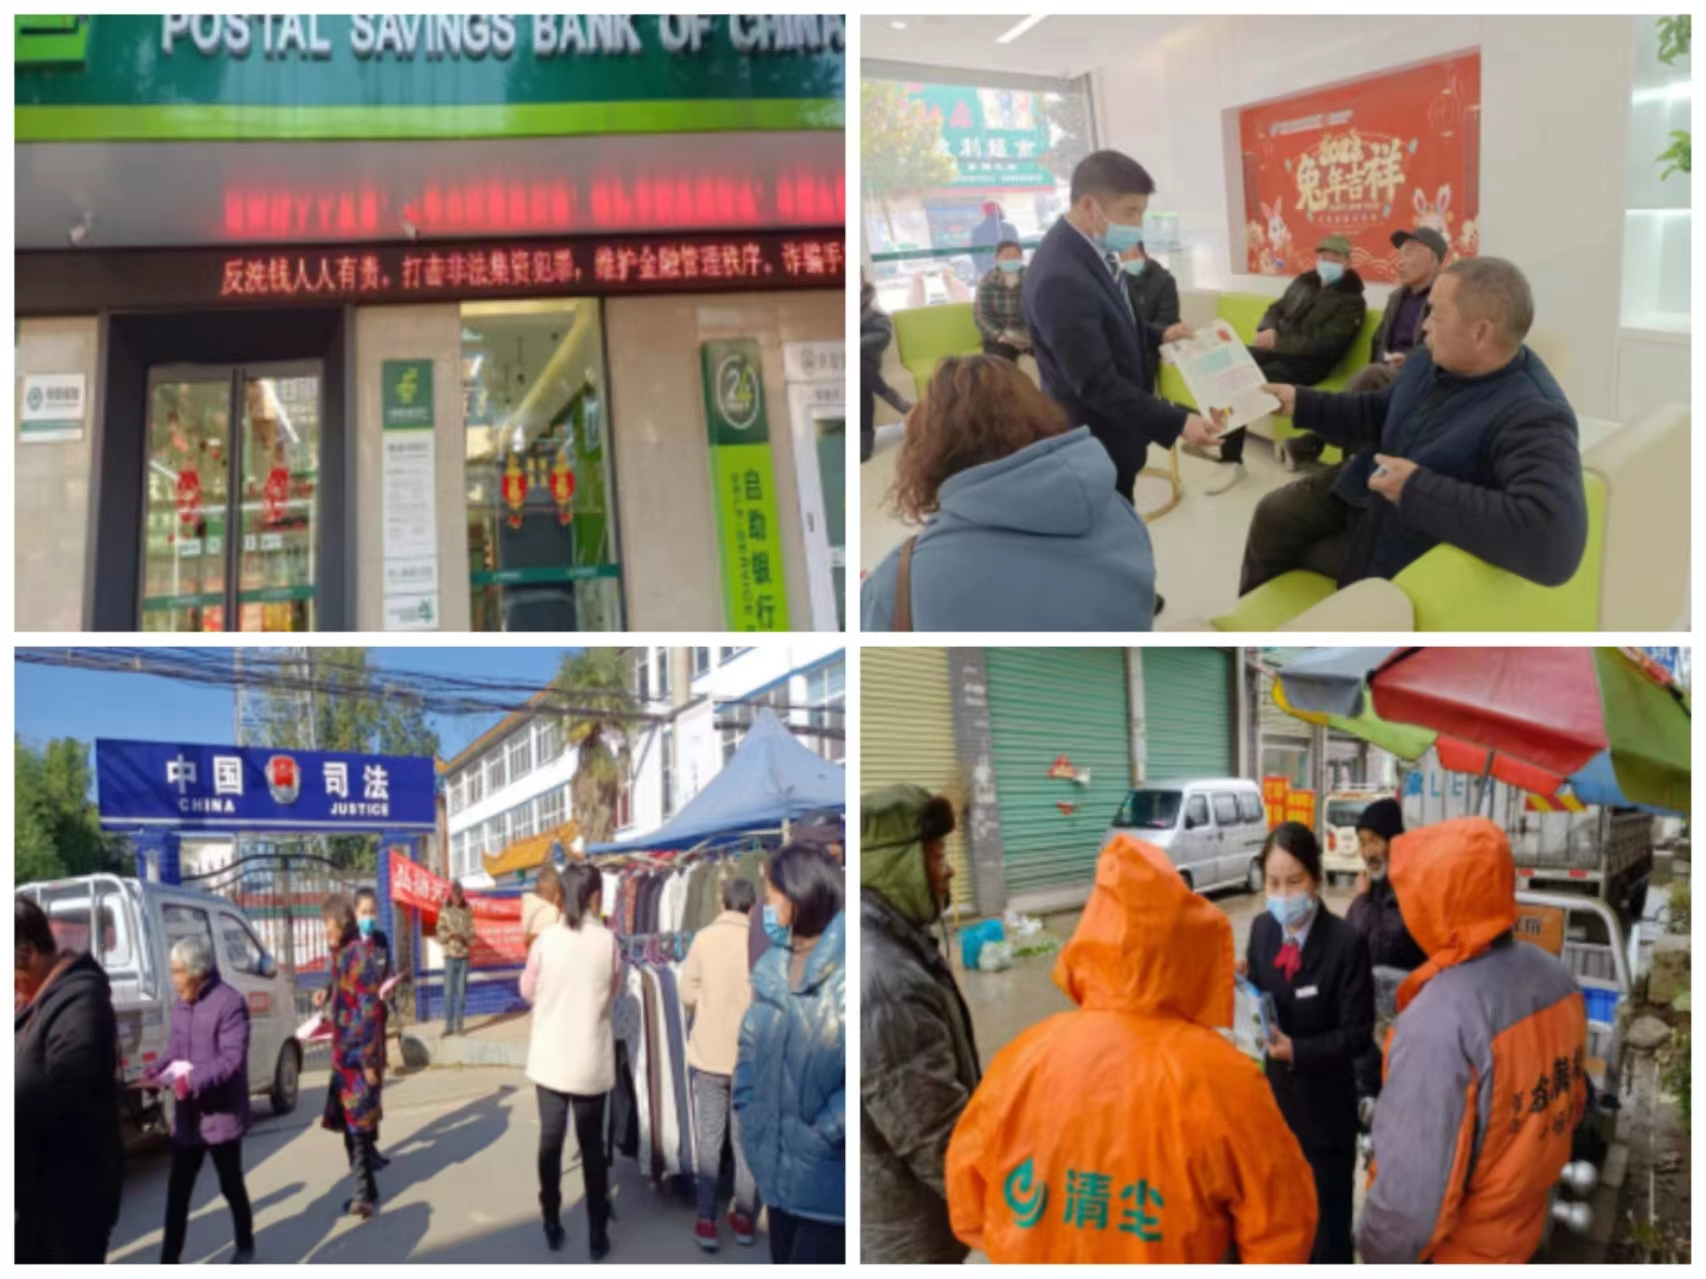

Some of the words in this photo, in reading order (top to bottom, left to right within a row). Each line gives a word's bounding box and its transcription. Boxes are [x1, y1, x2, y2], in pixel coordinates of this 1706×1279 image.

[162, 14, 331, 54] POSTAL
[350, 14, 517, 55] SAVINGS
[532, 14, 644, 53] BANK
[658, 14, 712, 51] OF
[729, 14, 845, 51] CHINA
[1296, 137, 1406, 212] 兔年吉祥
[166, 753, 244, 796] 中国
[322, 761, 390, 801] 司法
[179, 798, 236, 813] CHINA
[330, 802, 390, 818] JUSTICE
[1063, 1167, 1165, 1243] 清尘
